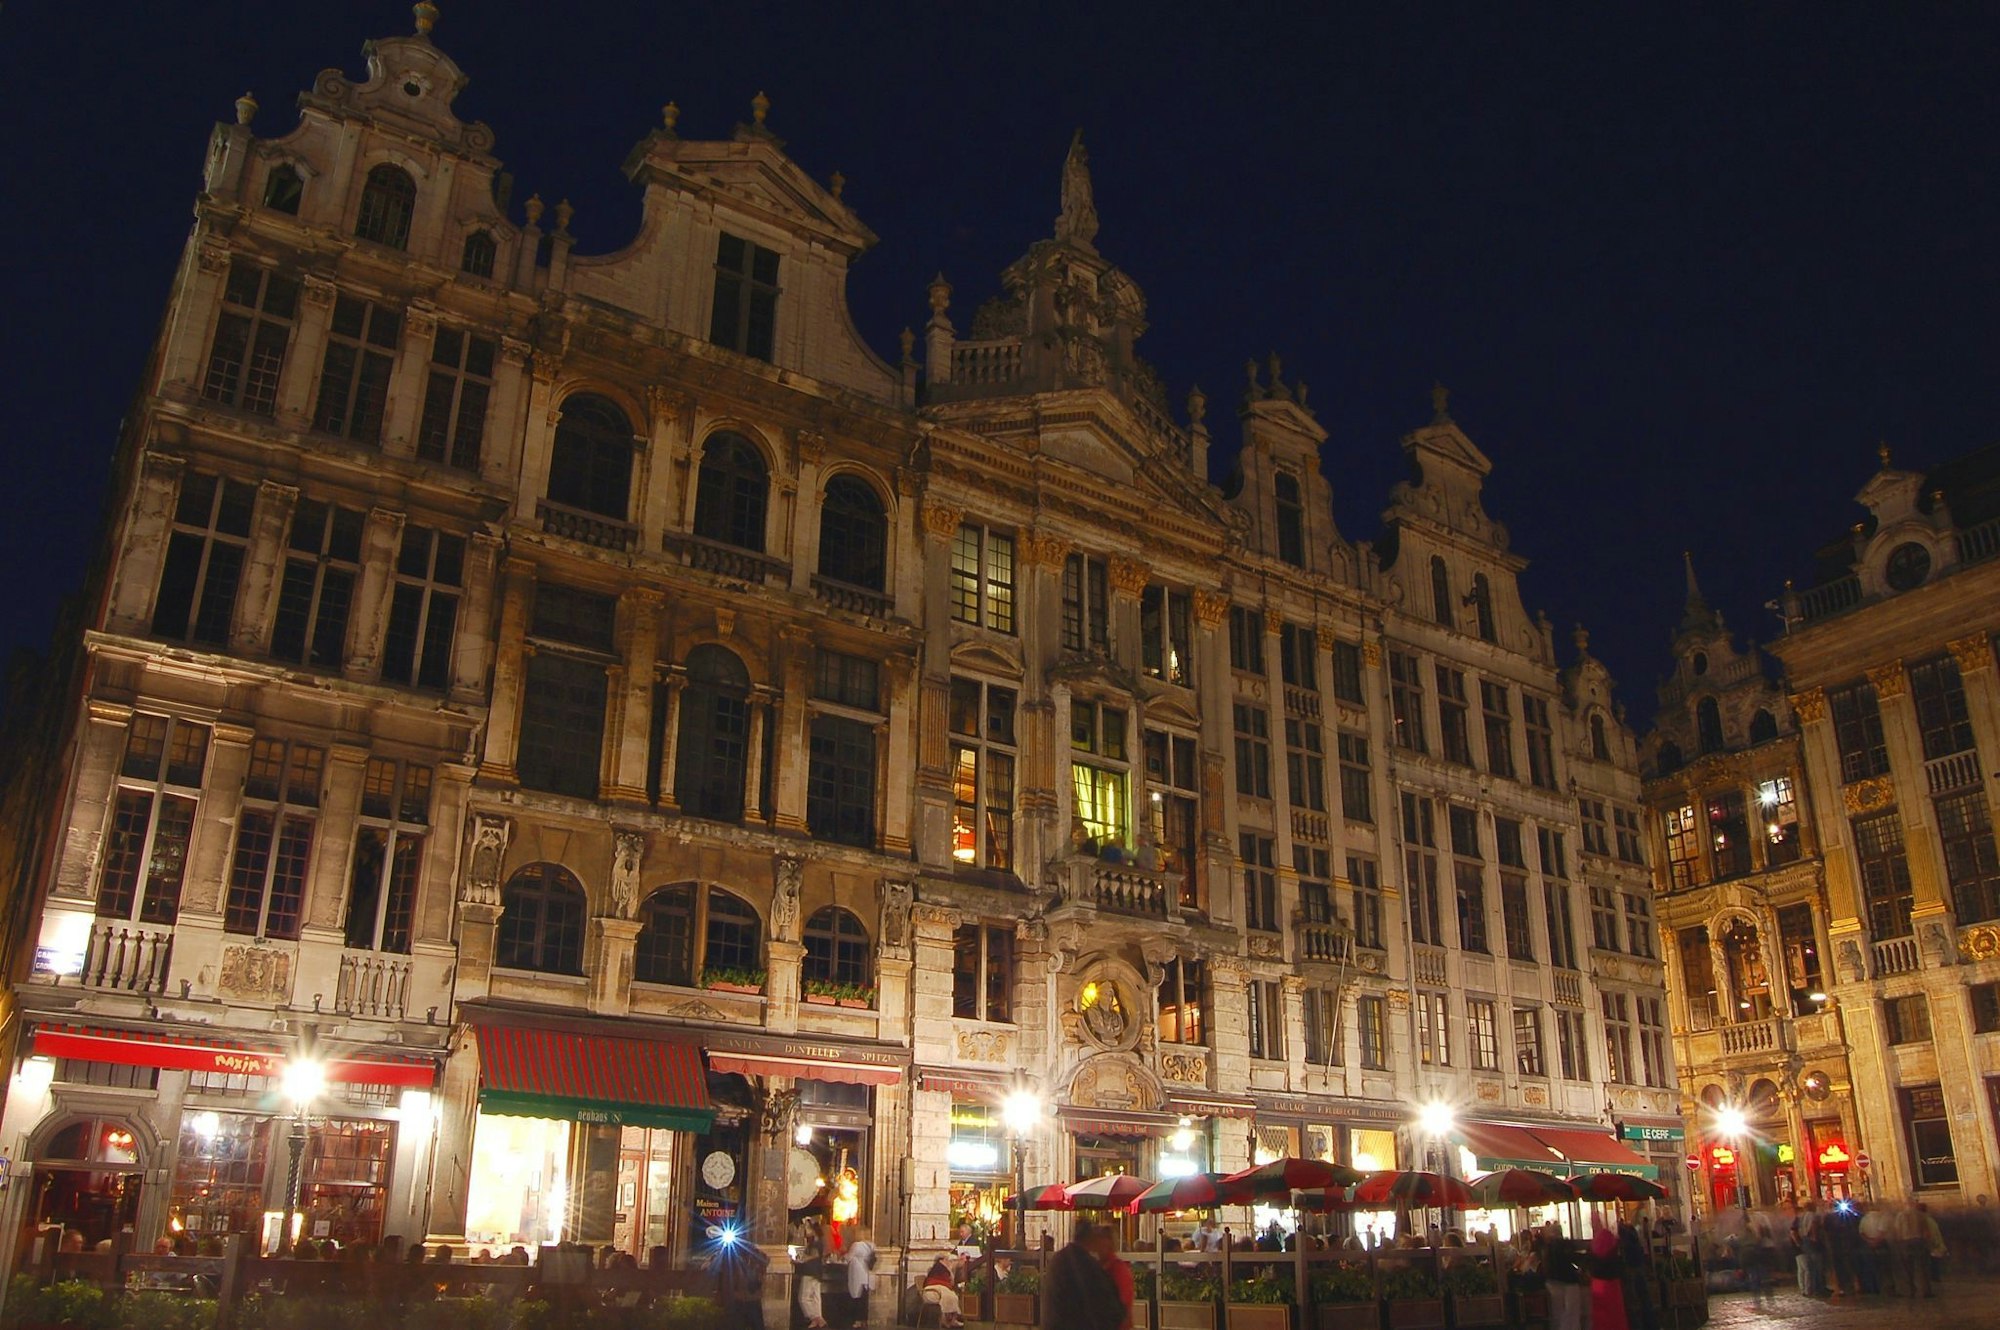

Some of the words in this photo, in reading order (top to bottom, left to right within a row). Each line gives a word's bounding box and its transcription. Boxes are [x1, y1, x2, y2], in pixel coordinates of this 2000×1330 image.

[785, 1044, 840, 1058] DENTELLES
[1641, 1128, 1652, 1138] LE
[1651, 1129, 1669, 1139] CERF
[696, 1199, 719, 1208] Maison
[700, 1208, 735, 1217] ANTOINE
